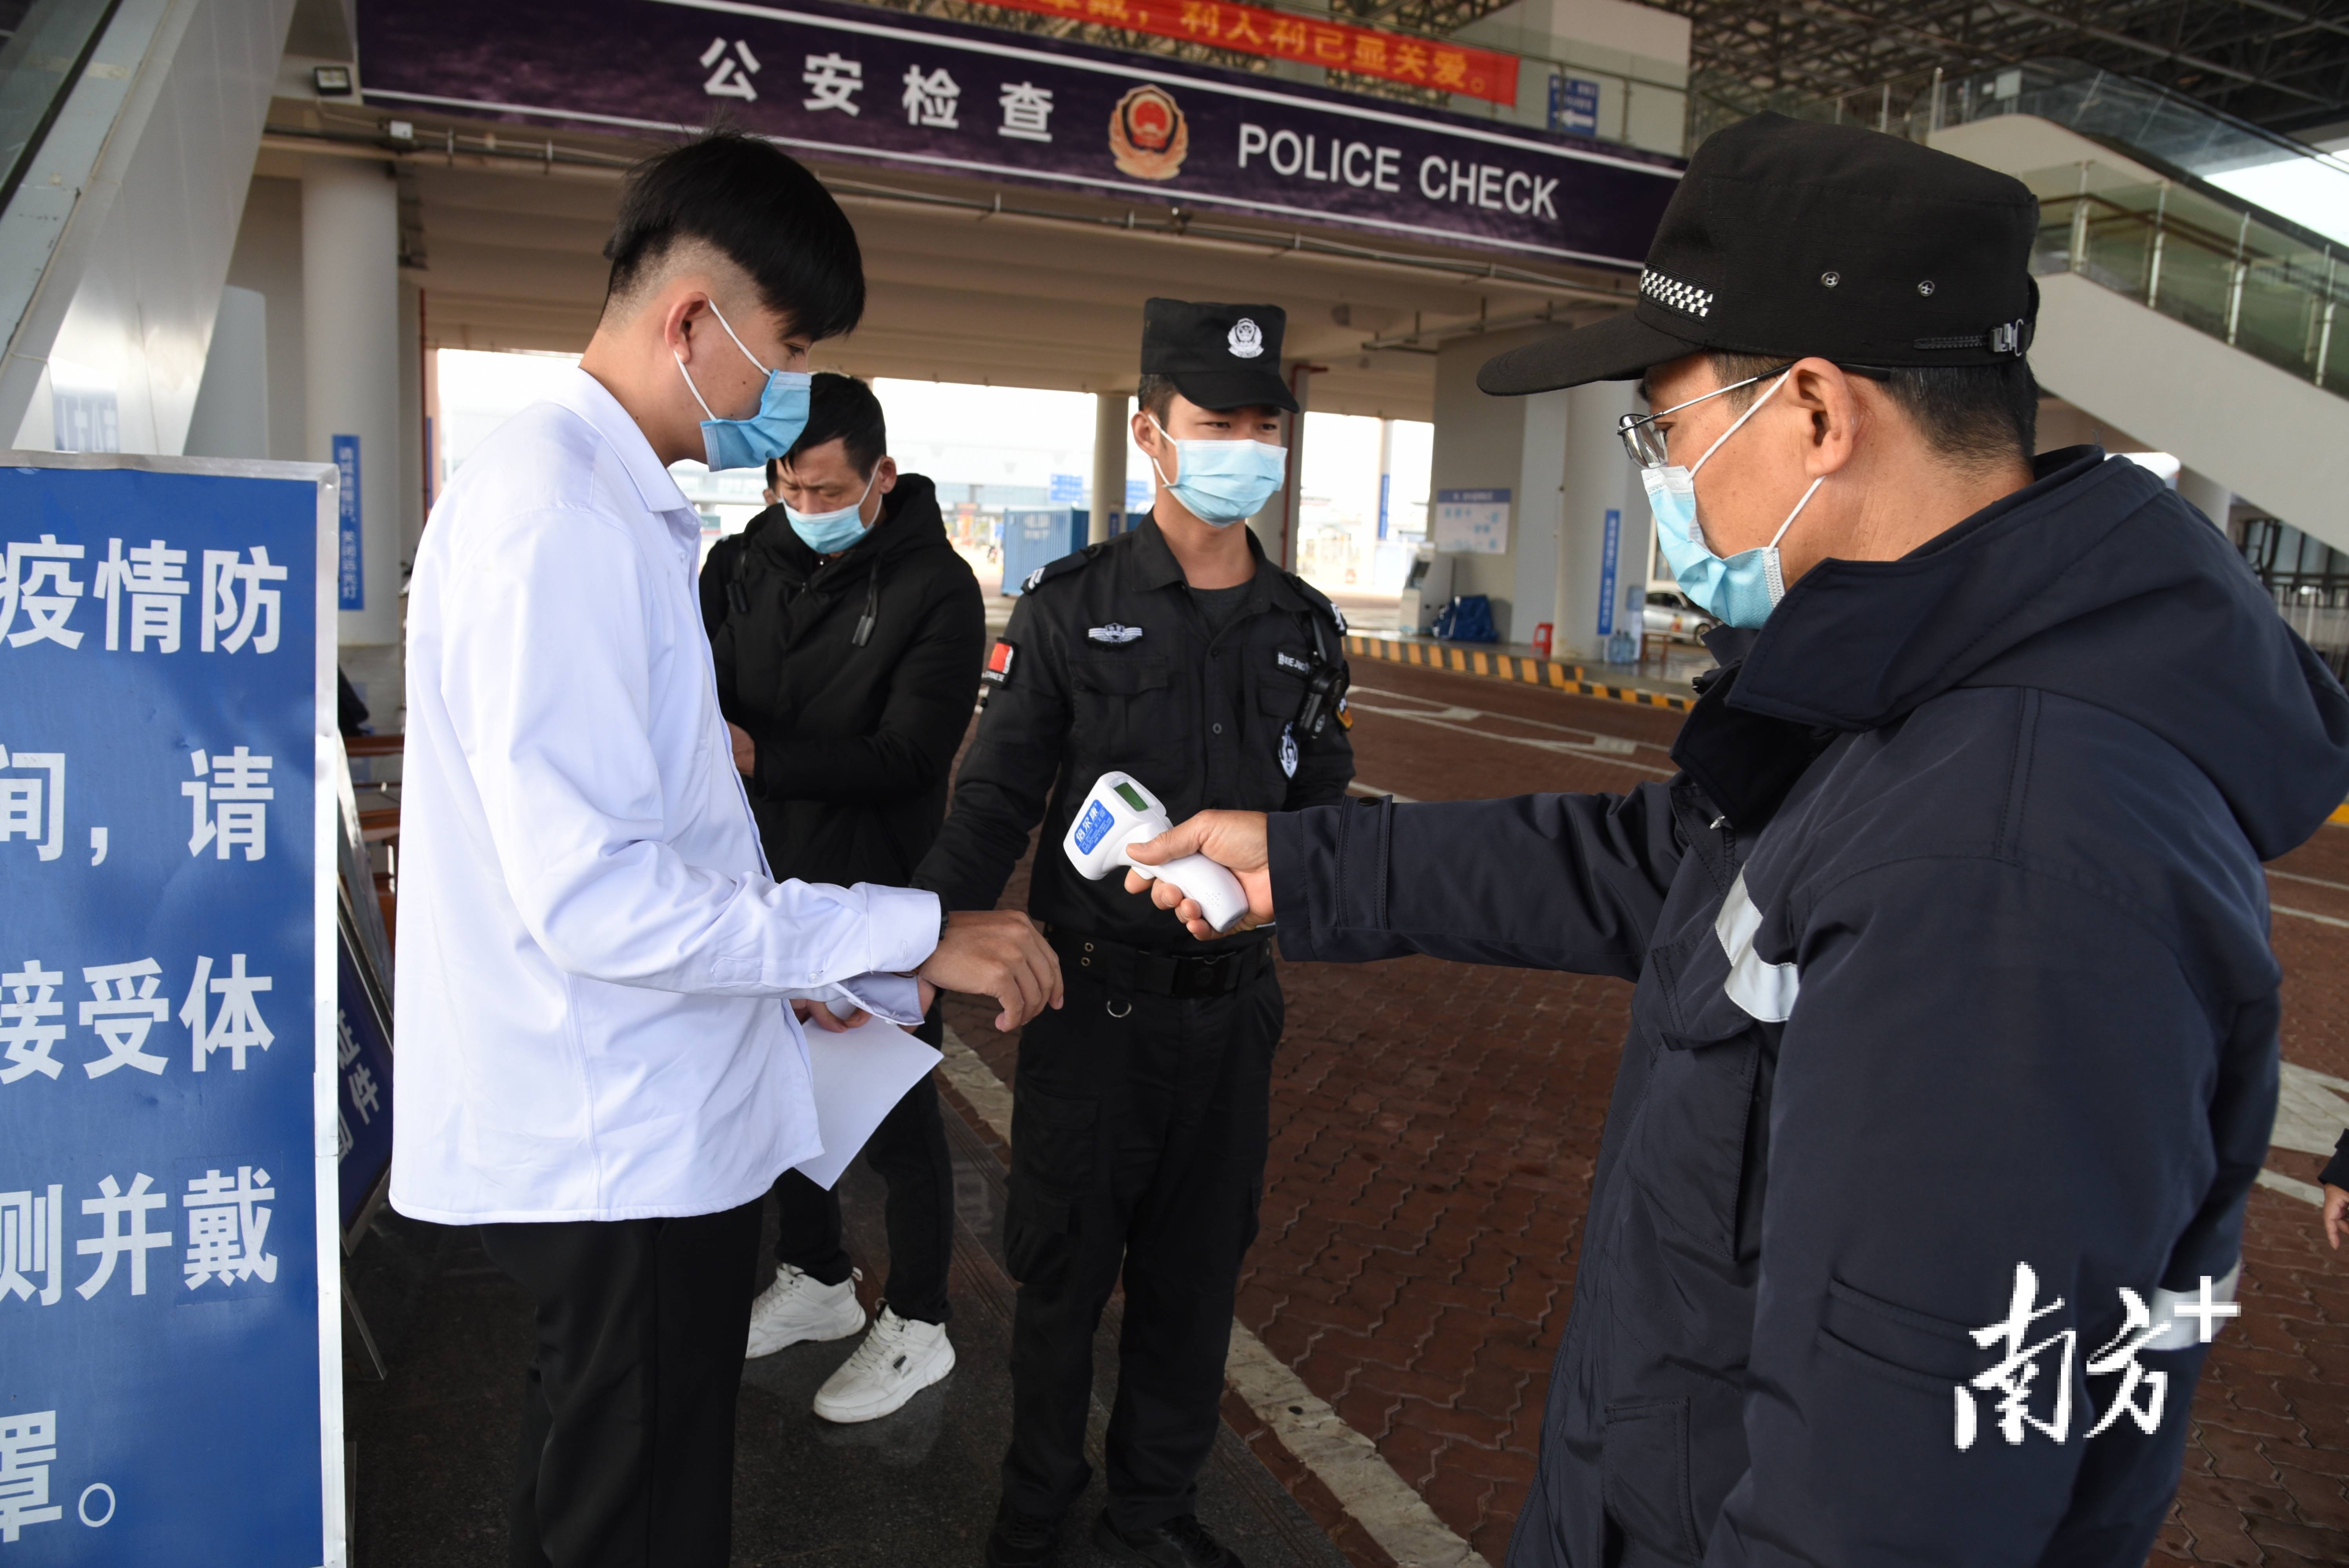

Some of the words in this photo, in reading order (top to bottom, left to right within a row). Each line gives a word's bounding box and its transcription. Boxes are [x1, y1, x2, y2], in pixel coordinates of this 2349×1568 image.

[699, 37, 1054, 143] 公安检查
[1238, 123, 1401, 192] POLICE
[1419, 156, 1560, 220] CHECK
[0, 534, 288, 654] 疫情防
